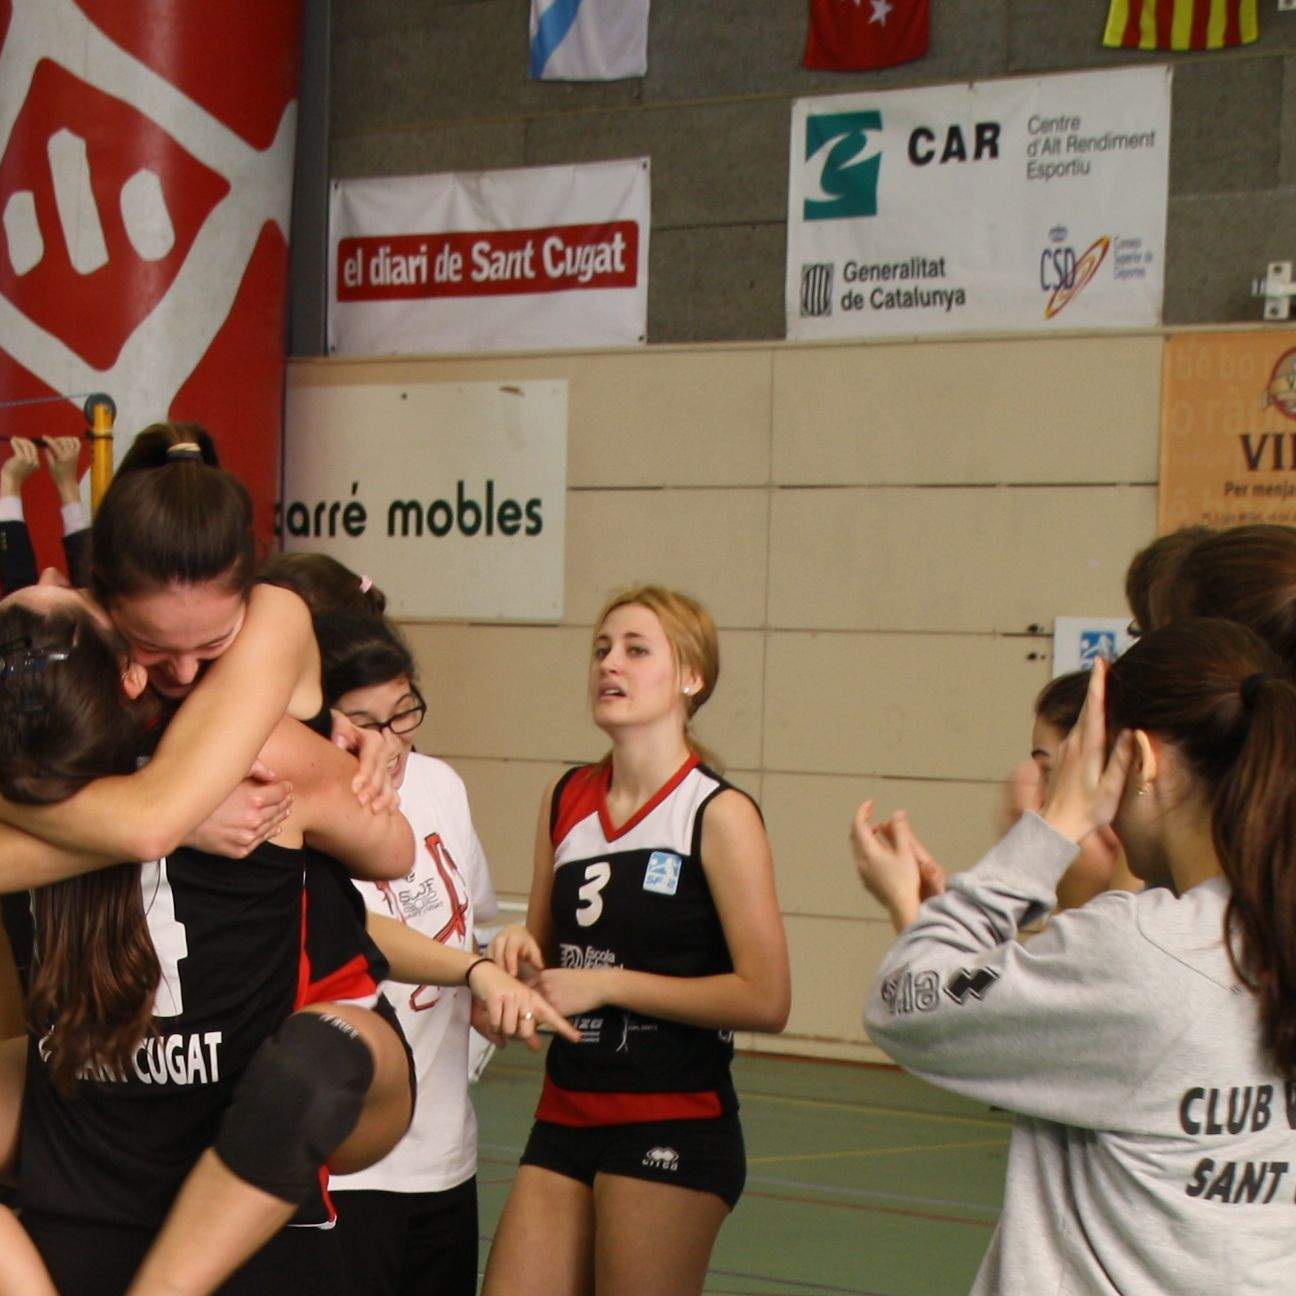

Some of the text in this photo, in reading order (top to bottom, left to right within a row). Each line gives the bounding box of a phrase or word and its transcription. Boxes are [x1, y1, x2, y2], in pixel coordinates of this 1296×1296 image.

[908, 121, 1002, 166] CAR
[1027, 114, 1081, 135] Centre
[1066, 130, 1156, 154] Rendiment
[1026, 159, 1091, 182] Esportiu
[343, 231, 627, 288] el diari de Sant Cugat
[843, 256, 946, 282] Generalitat
[840, 285, 967, 315] de Catalunya
[387, 479, 544, 538] mobles
[1224, 481, 1248, 497] Per
[575, 861, 612, 927] 3
[131, 1031, 223, 1086] CUGAT
[1178, 1084, 1274, 1136] CLUB
[1185, 1157, 1289, 1205] SANT
